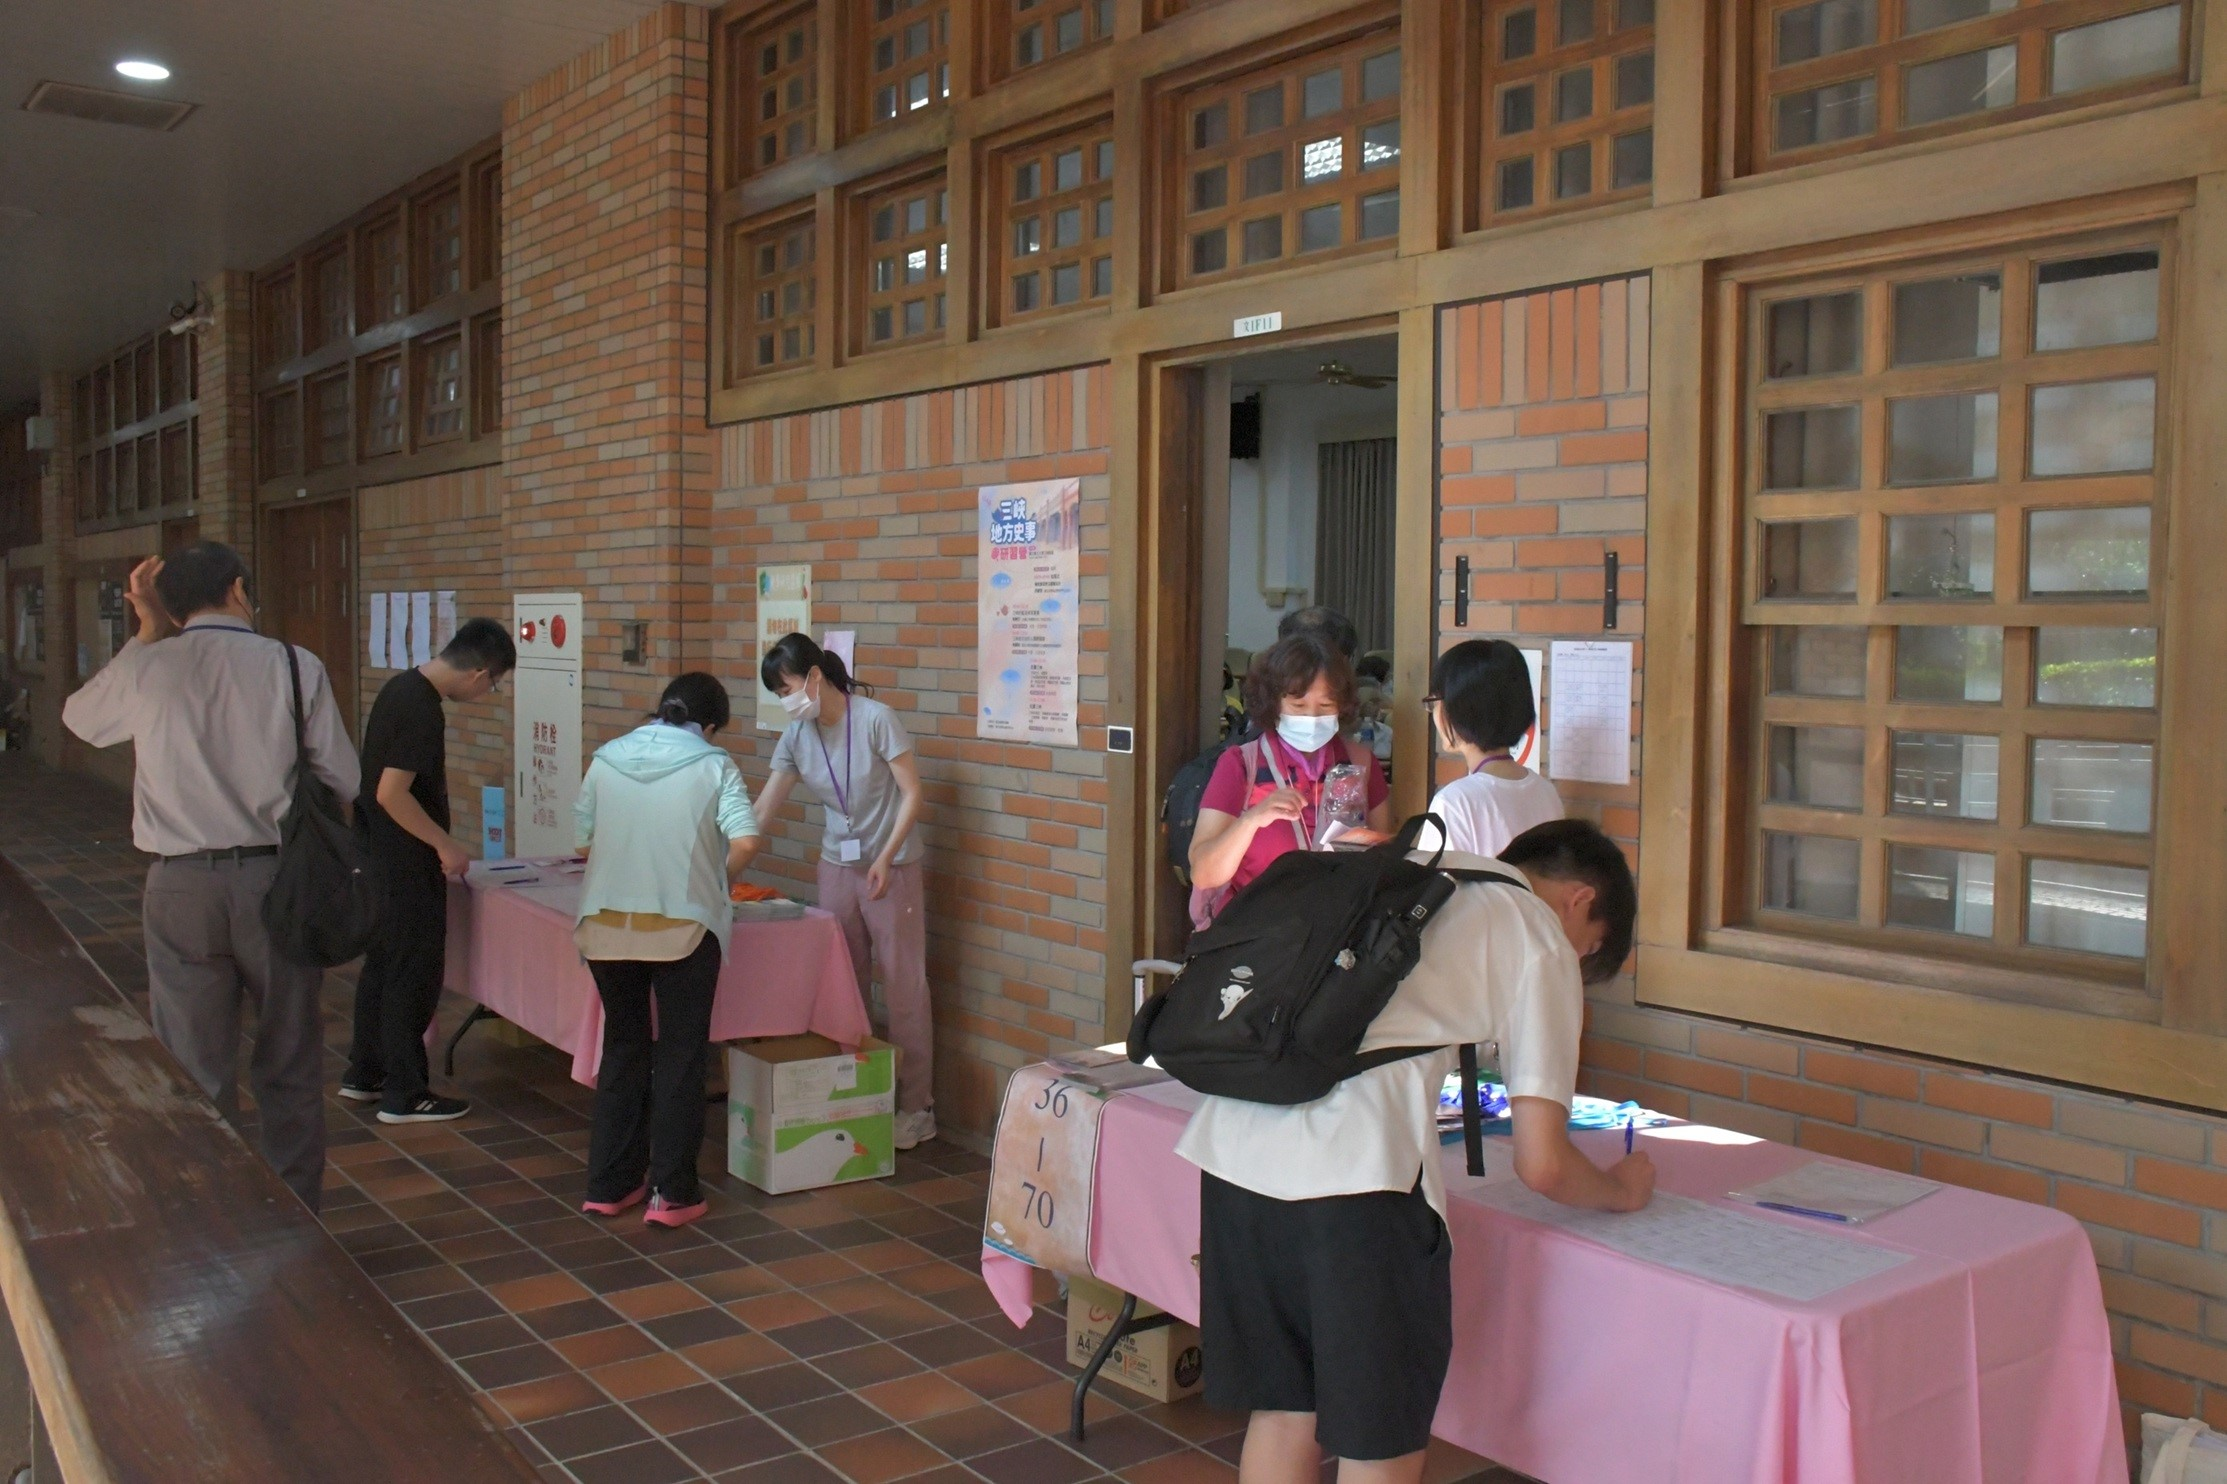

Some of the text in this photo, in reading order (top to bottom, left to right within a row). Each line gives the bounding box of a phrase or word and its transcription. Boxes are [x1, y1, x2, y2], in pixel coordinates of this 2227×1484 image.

[1000, 498, 1026, 521] 三峽
[990, 521, 1037, 544] 地方史事
[532, 721, 557, 744] 消防栓
[1034, 1077, 1069, 1119] 36
[1020, 1182, 1055, 1229] 70
[1077, 1334, 1091, 1352] A4
